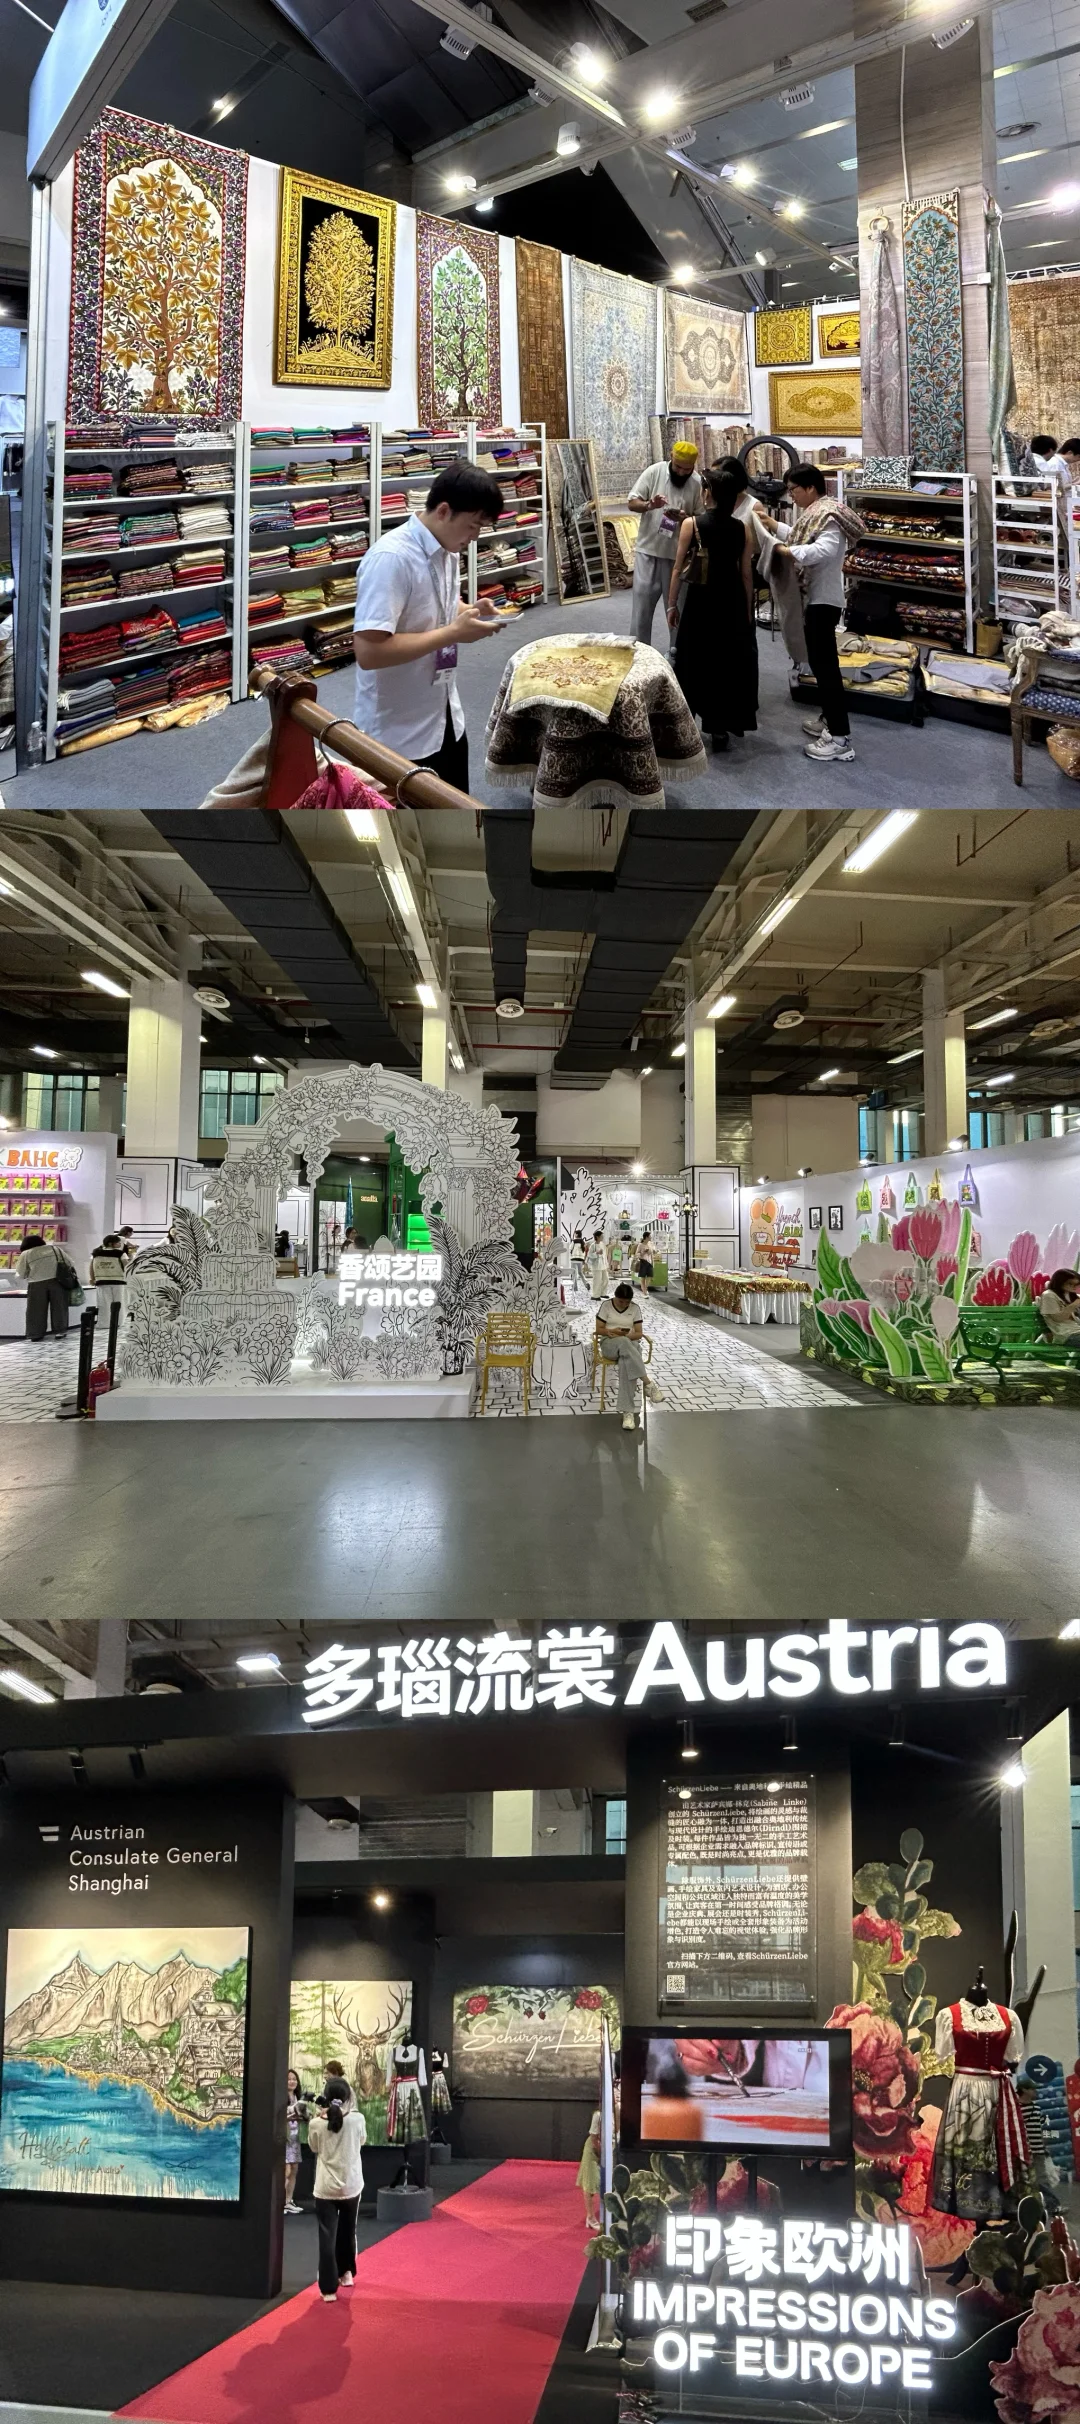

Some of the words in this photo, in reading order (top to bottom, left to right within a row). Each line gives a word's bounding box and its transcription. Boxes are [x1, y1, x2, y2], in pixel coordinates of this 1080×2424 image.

[336, 1253, 442, 1281] 香颂艺园
[338, 1281, 436, 1307] France
[301, 1626, 619, 1725] 多瑙流裳
[624, 1619, 1007, 1706] Austria
[70, 1825, 145, 1841] Austrian
[69, 1848, 159, 1866] Consulate
[166, 1845, 238, 1864] General
[68, 1873, 149, 1896] Shanghai
[1042, 2129, 1060, 2138] 生间
[665, 2214, 910, 2286] 印象欧洲
[633, 2279, 957, 2340] IMPRESSIONS
[653, 2331, 717, 2372] OF
[735, 2335, 933, 2390] EUROPE
